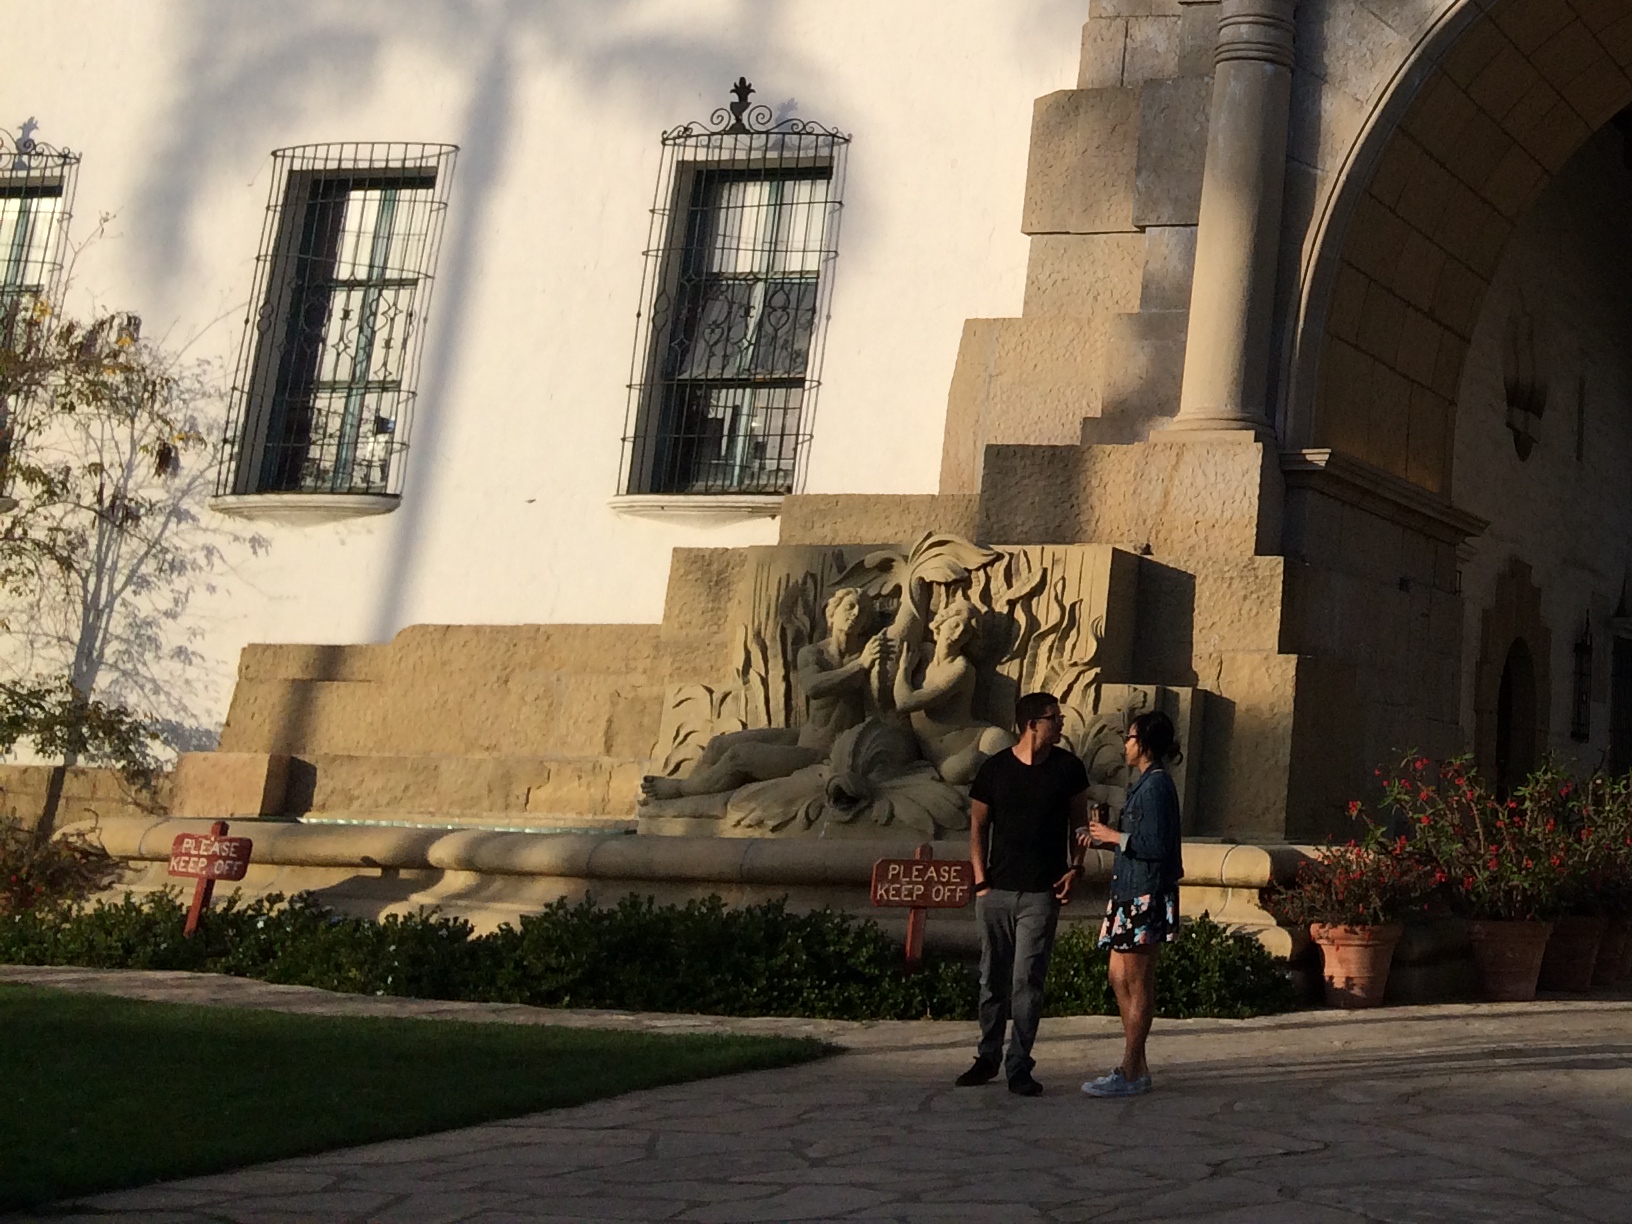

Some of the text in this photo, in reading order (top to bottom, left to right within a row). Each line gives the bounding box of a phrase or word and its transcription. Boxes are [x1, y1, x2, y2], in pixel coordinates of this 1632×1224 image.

[181, 837, 240, 857] PLEASE
[168, 856, 244, 876] KEEP OFF
[887, 864, 963, 883] PLEASE
[876, 883, 969, 902] KEEP OFF
